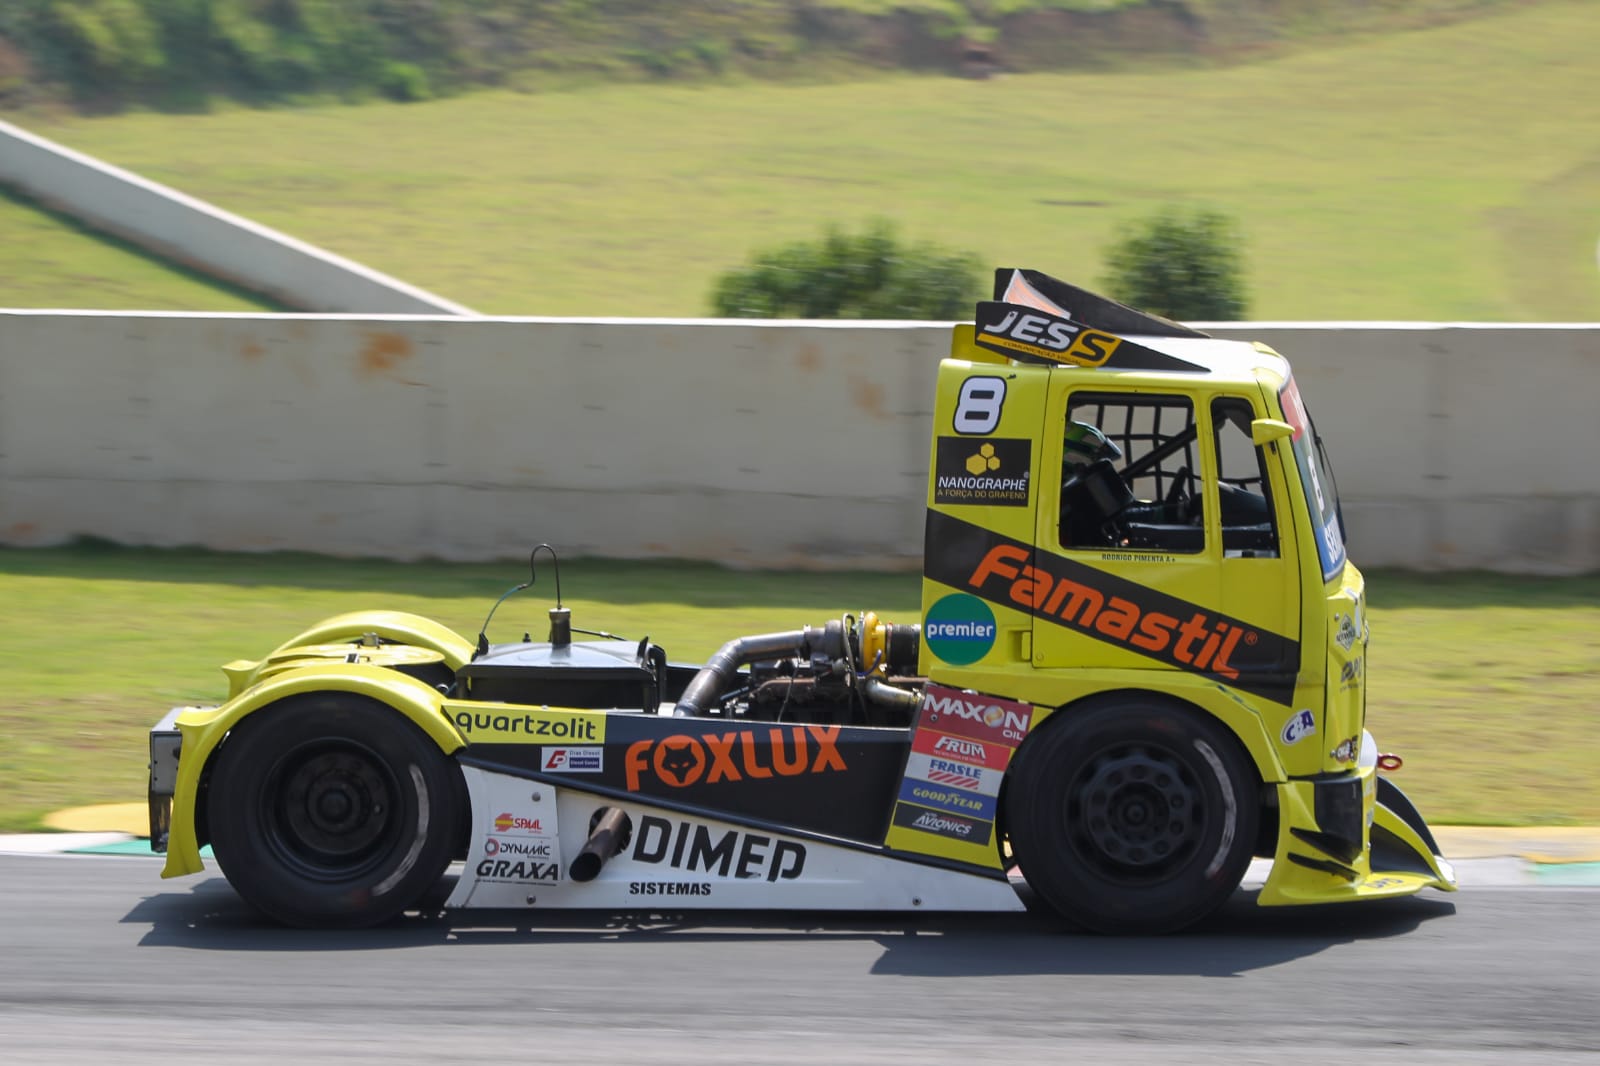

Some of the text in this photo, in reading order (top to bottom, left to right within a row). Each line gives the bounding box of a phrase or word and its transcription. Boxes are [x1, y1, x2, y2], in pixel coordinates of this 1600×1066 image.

[984, 310, 1116, 362] JESS
[953, 375, 1007, 436] 8
[938, 476, 1026, 491] NANOGRAPHE
[945, 490, 973, 498] FORÇA
[975, 490, 987, 498] DO
[988, 491, 1026, 500] GRAFENO
[969, 544, 1244, 680] Famastil
[927, 623, 993, 639] premier
[923, 694, 1028, 732] MAXON
[455, 711, 596, 741] quartzolit
[1002, 729, 1023, 741] OIL
[624, 725, 848, 793] FOXLUX
[935, 736, 986, 759] FRUM
[912, 787, 983, 811] GOODYEAR
[914, 815, 972, 834] AVIONICS
[500, 841, 551, 856] DYNAMIC
[632, 815, 807, 883] DIMEP
[476, 859, 559, 881] GRAXA
[629, 882, 711, 896] SISTEMAS
